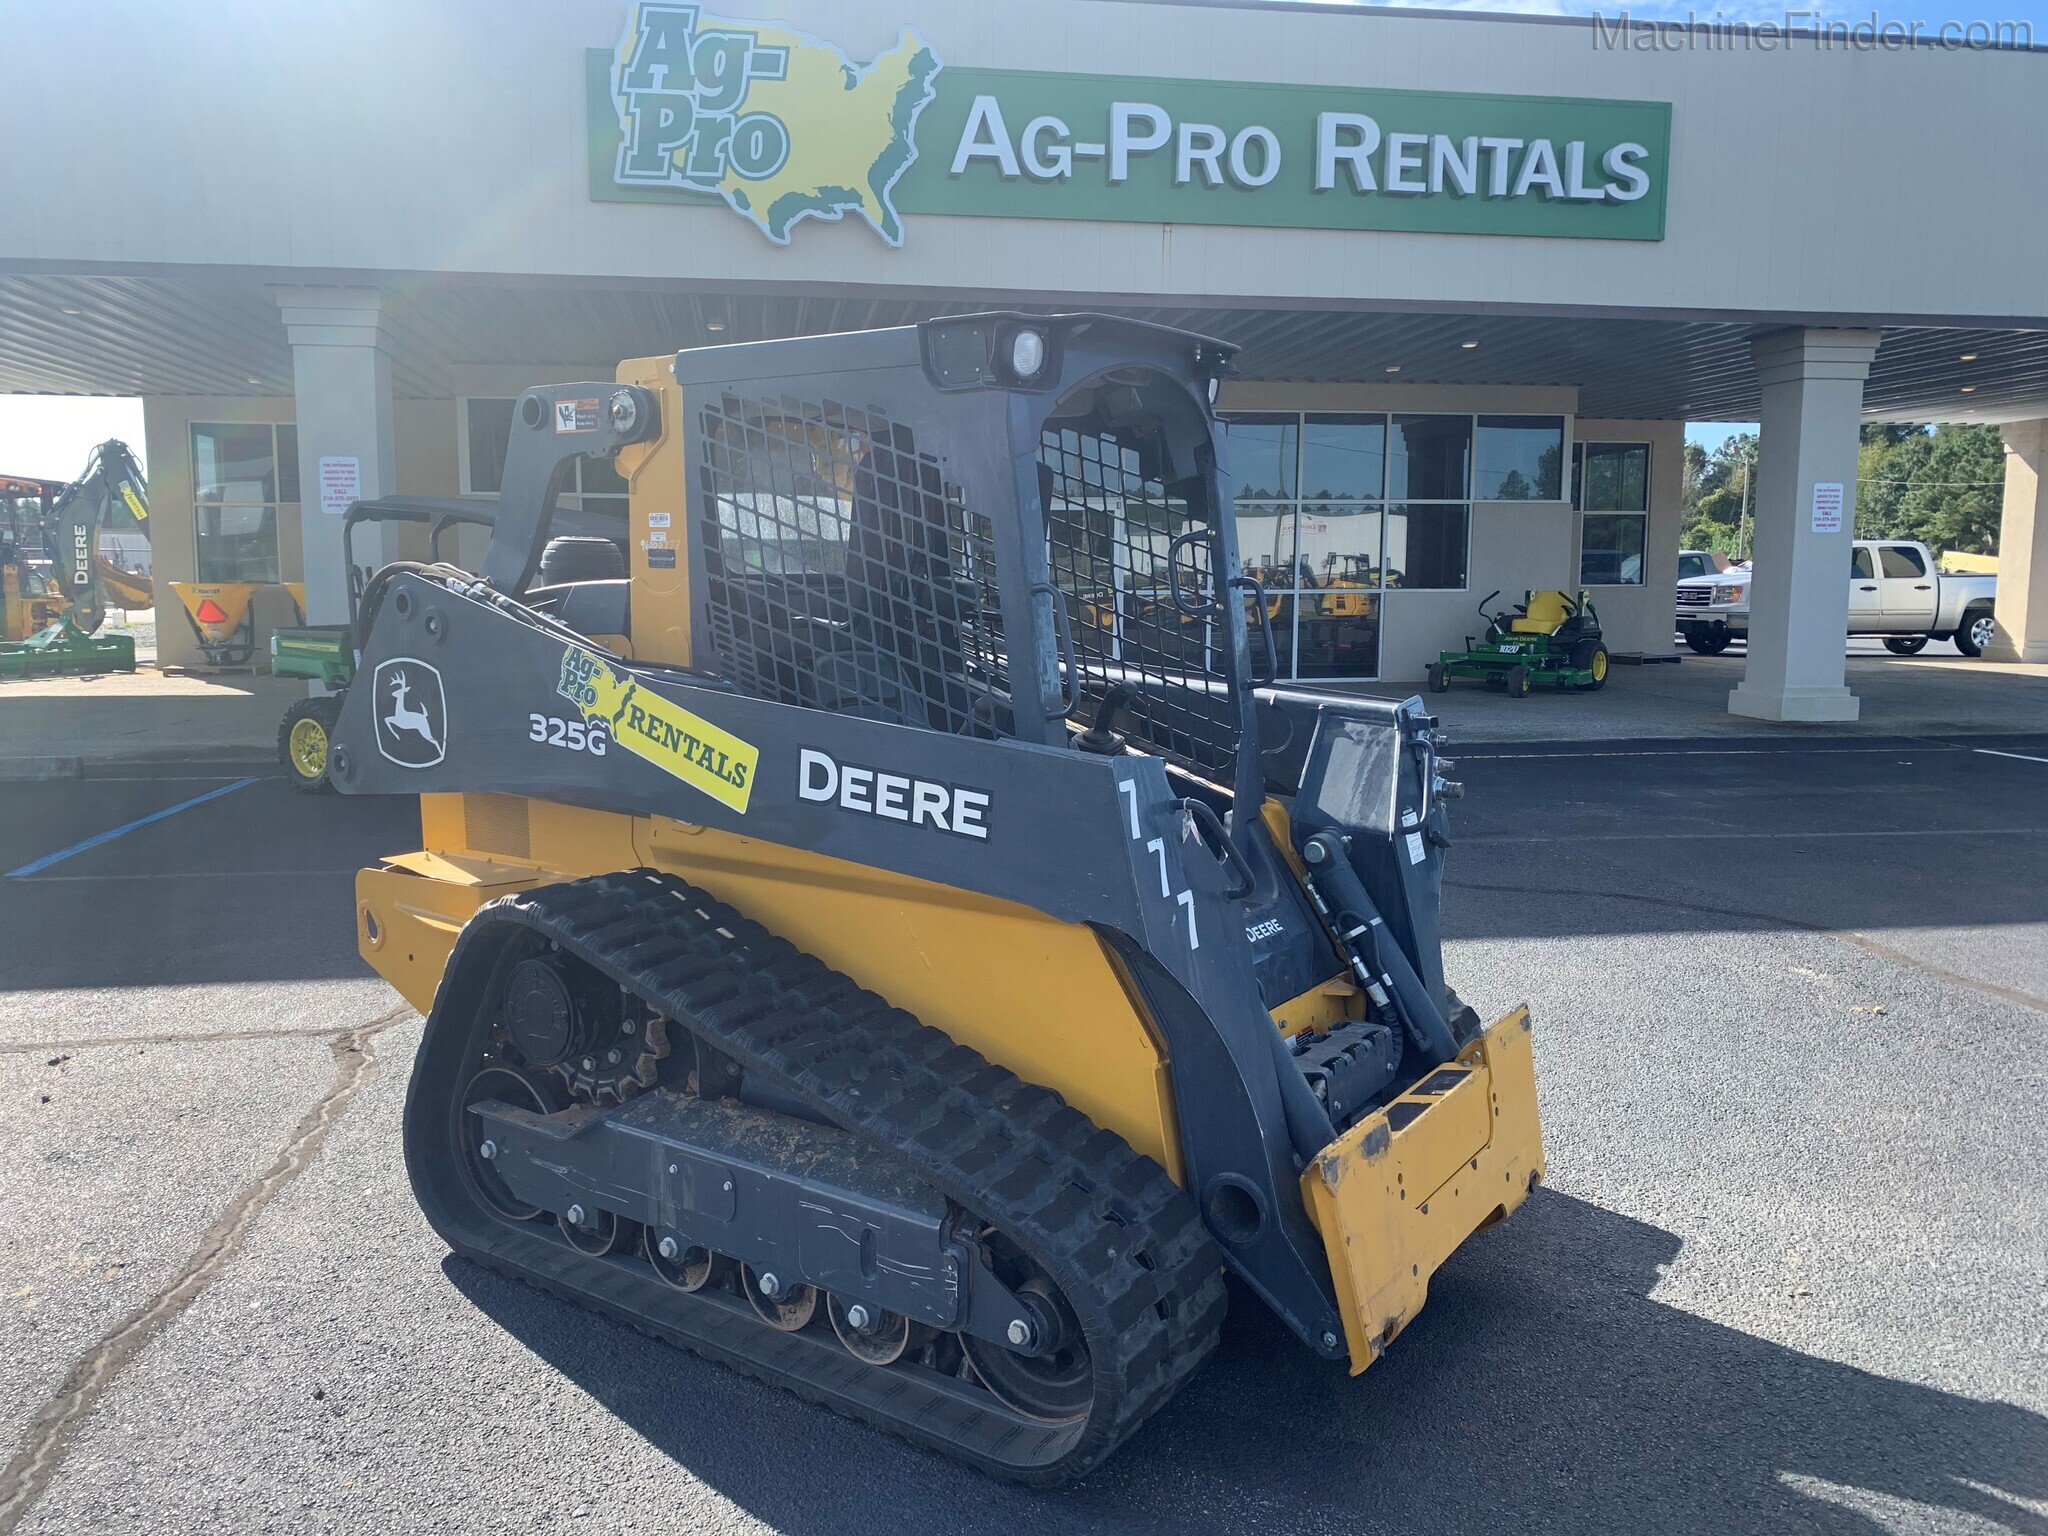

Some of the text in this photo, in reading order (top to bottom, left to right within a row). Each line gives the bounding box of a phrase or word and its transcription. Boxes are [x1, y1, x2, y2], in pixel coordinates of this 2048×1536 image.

[622, 8, 787, 110] Ag-
[625, 94, 787, 178] Pro
[74, 524, 88, 584] DEERE
[561, 670, 597, 706] Pro
[565, 650, 603, 682] Ag-
[529, 713, 606, 756] 325G
[627, 703, 748, 789] RENTALS
[1245, 918, 1284, 943] DEERE
